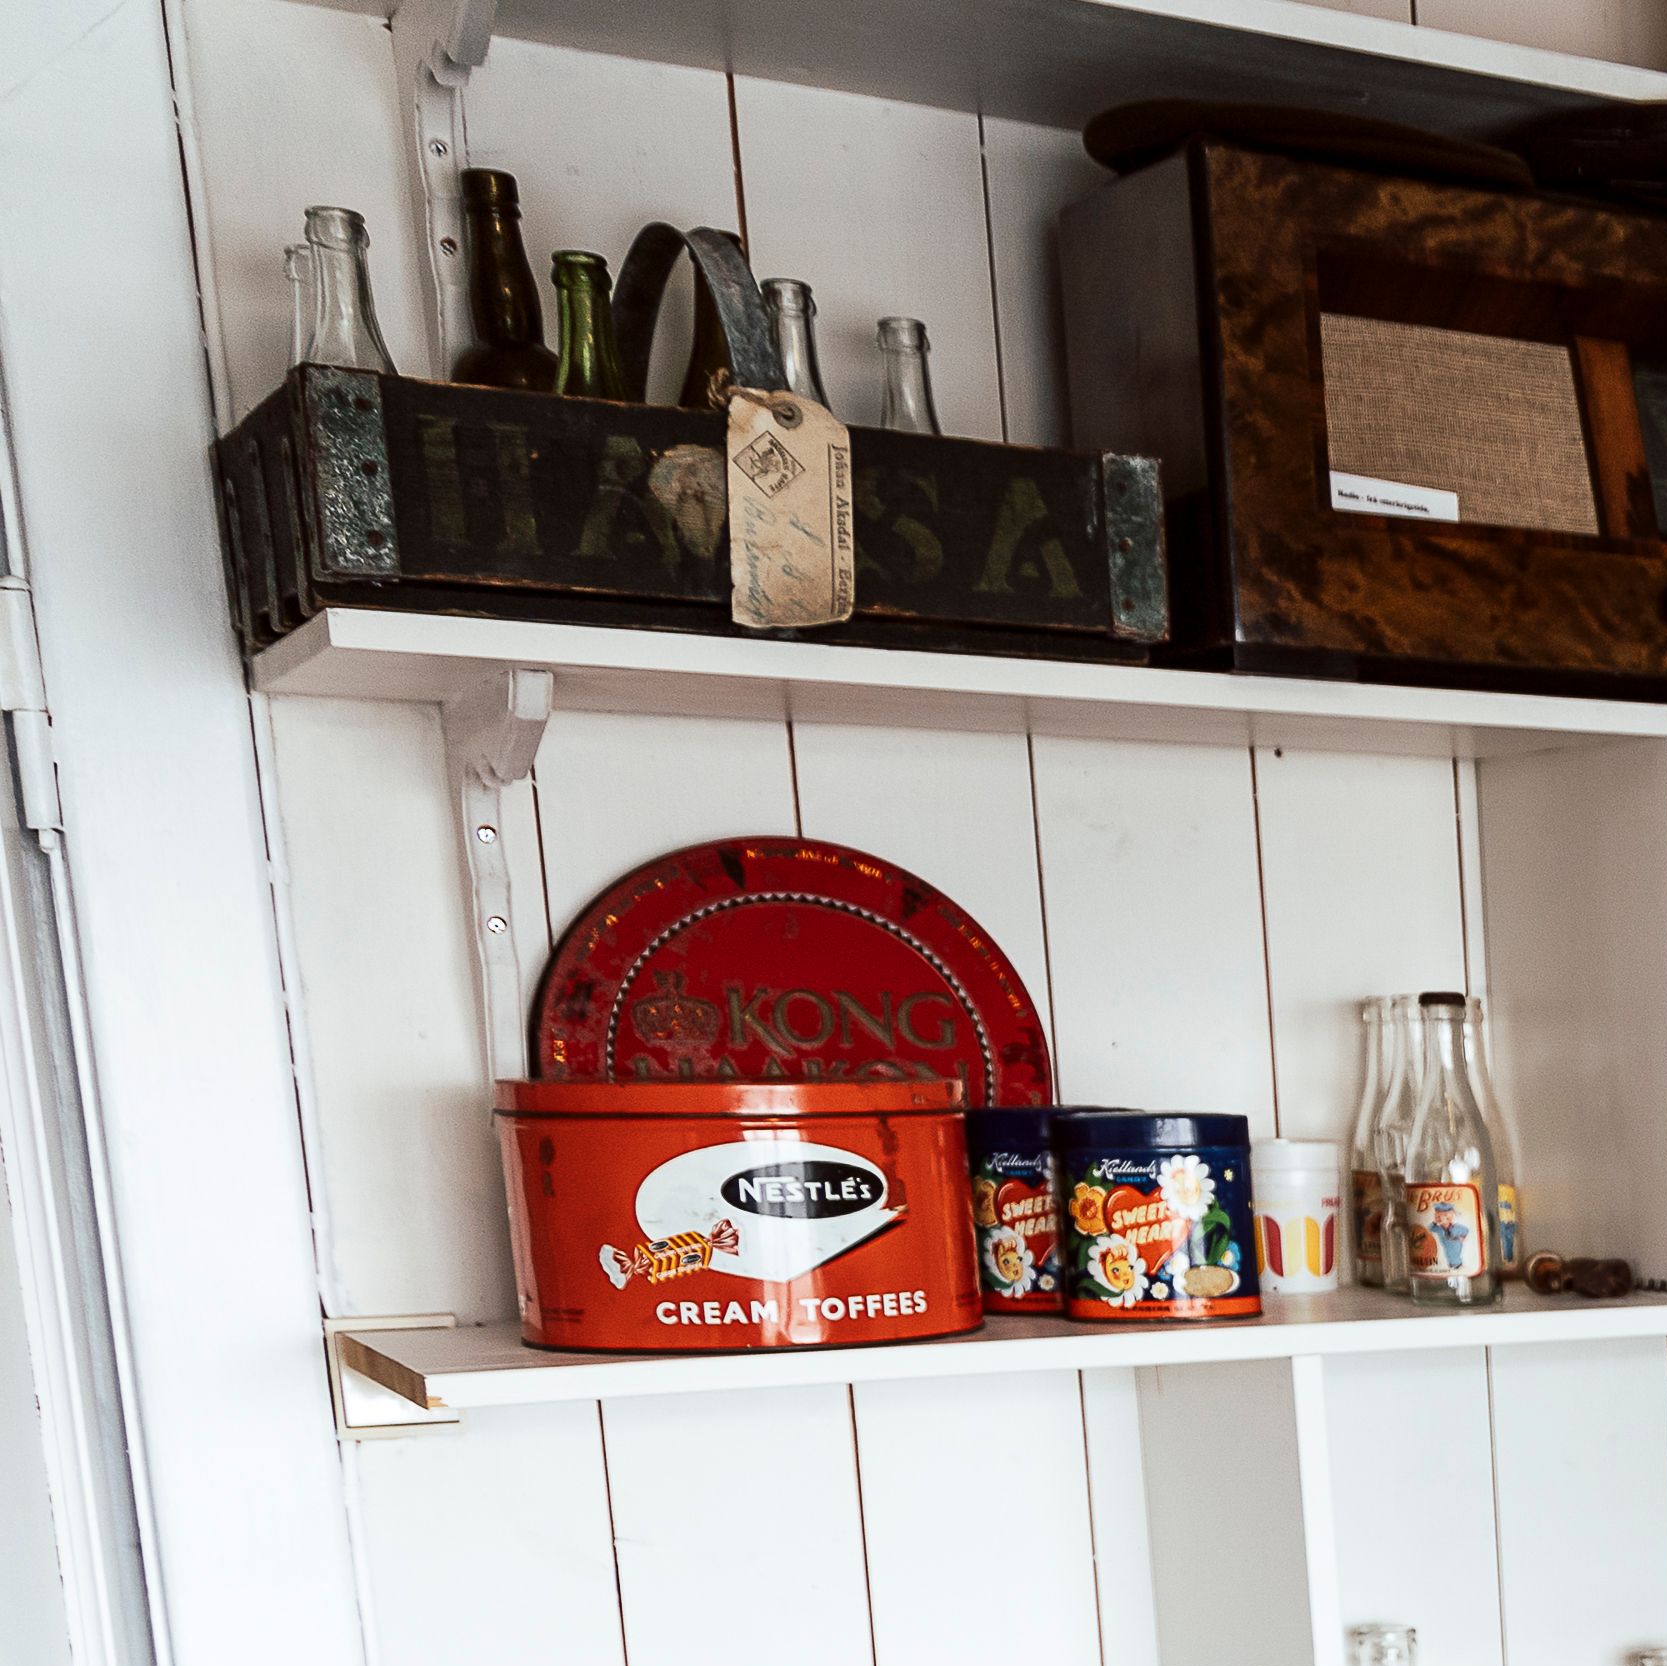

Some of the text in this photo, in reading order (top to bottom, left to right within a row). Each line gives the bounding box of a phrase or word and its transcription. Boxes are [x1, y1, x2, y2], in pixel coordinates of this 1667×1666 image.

[419, 411, 1088, 602] HASA
[723, 984, 957, 1058] KONG
[1093, 1158, 1157, 1181] Kiellands
[656, 1290, 928, 1326] CREAM TOFFEES
